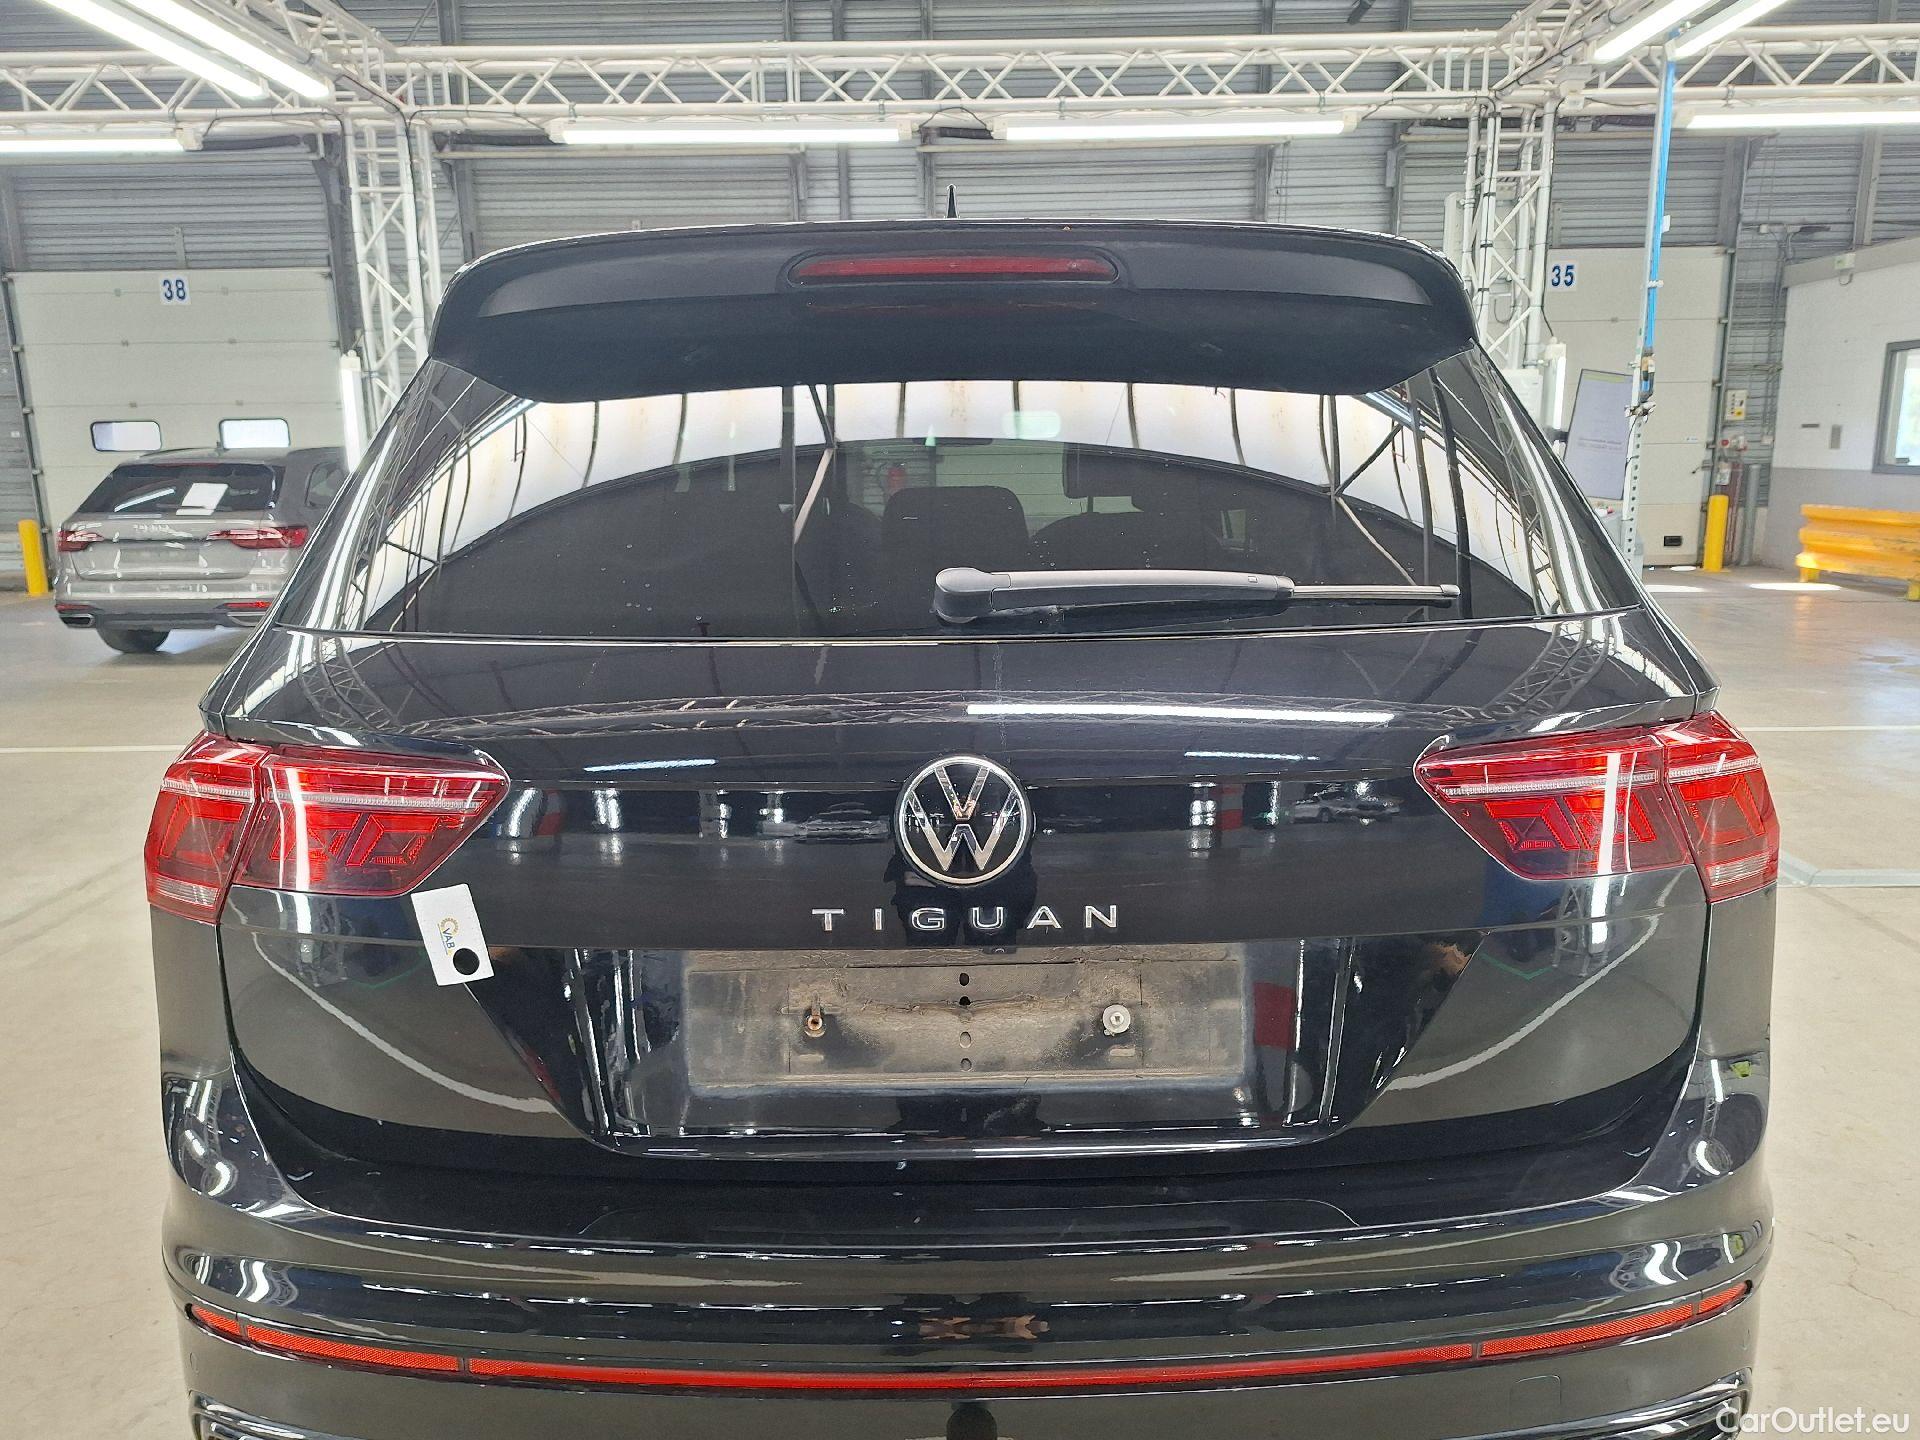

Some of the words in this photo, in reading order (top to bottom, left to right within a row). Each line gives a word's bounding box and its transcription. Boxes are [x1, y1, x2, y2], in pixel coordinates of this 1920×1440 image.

[1551, 265, 1575, 287] 35
[162, 279, 186, 301] 38
[811, 904, 1118, 933] TIGUAN
[442, 927, 456, 949] VAB
